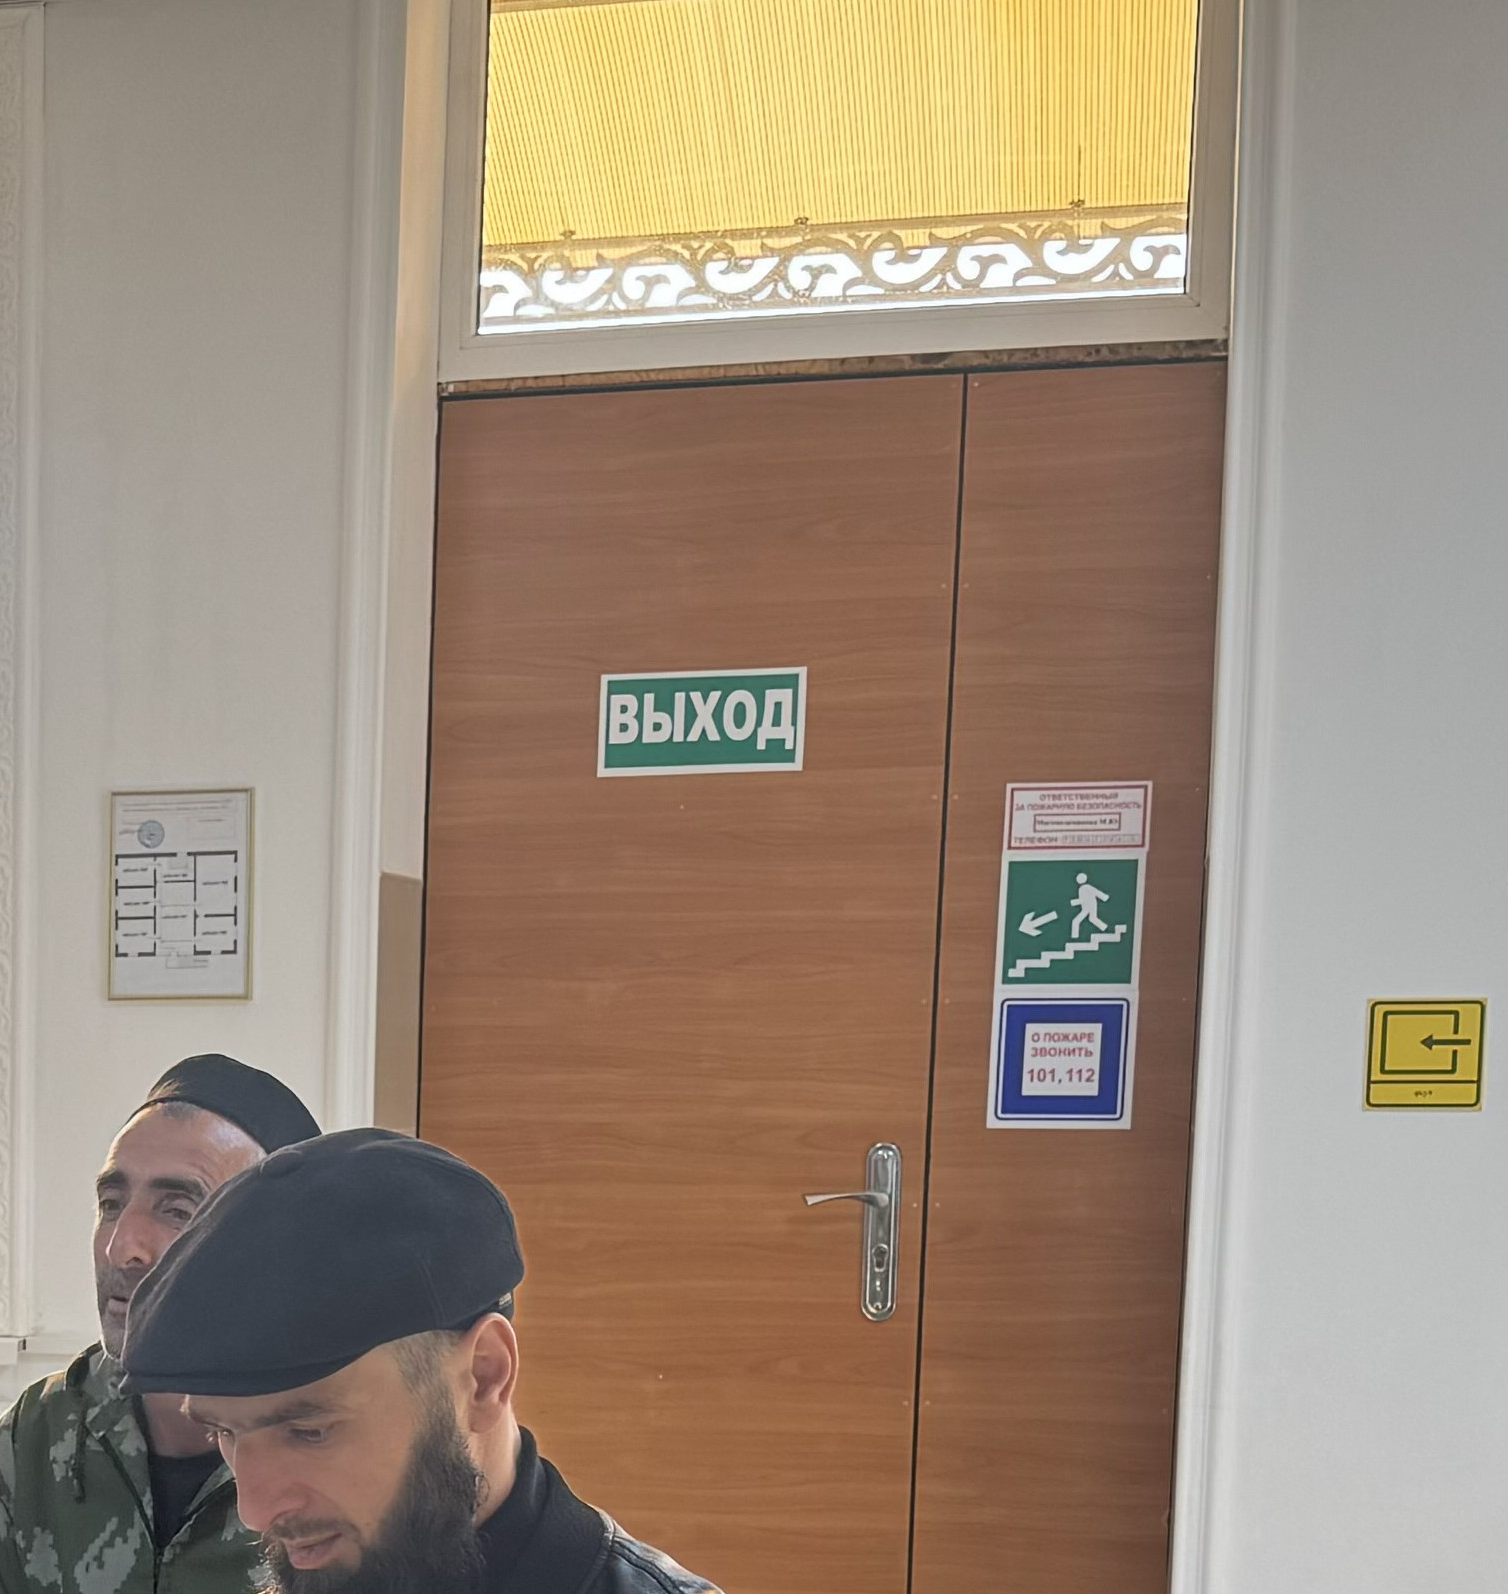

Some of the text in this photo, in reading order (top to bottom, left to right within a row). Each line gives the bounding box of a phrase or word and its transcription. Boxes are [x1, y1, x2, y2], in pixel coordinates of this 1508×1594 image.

[608, 688, 795, 750] ВЫХОД
[1039, 792, 1119, 801] ОТВЕТСТВЕННЫЙ
[1076, 801, 1141, 811] БЕЗОПАСНОСТЬ
[1031, 1032, 1095, 1043] О ПОЖАРЕ
[1030, 1047, 1094, 1058] ЗВОНИТЬ
[1027, 1068, 1096, 1085] 101, 112
